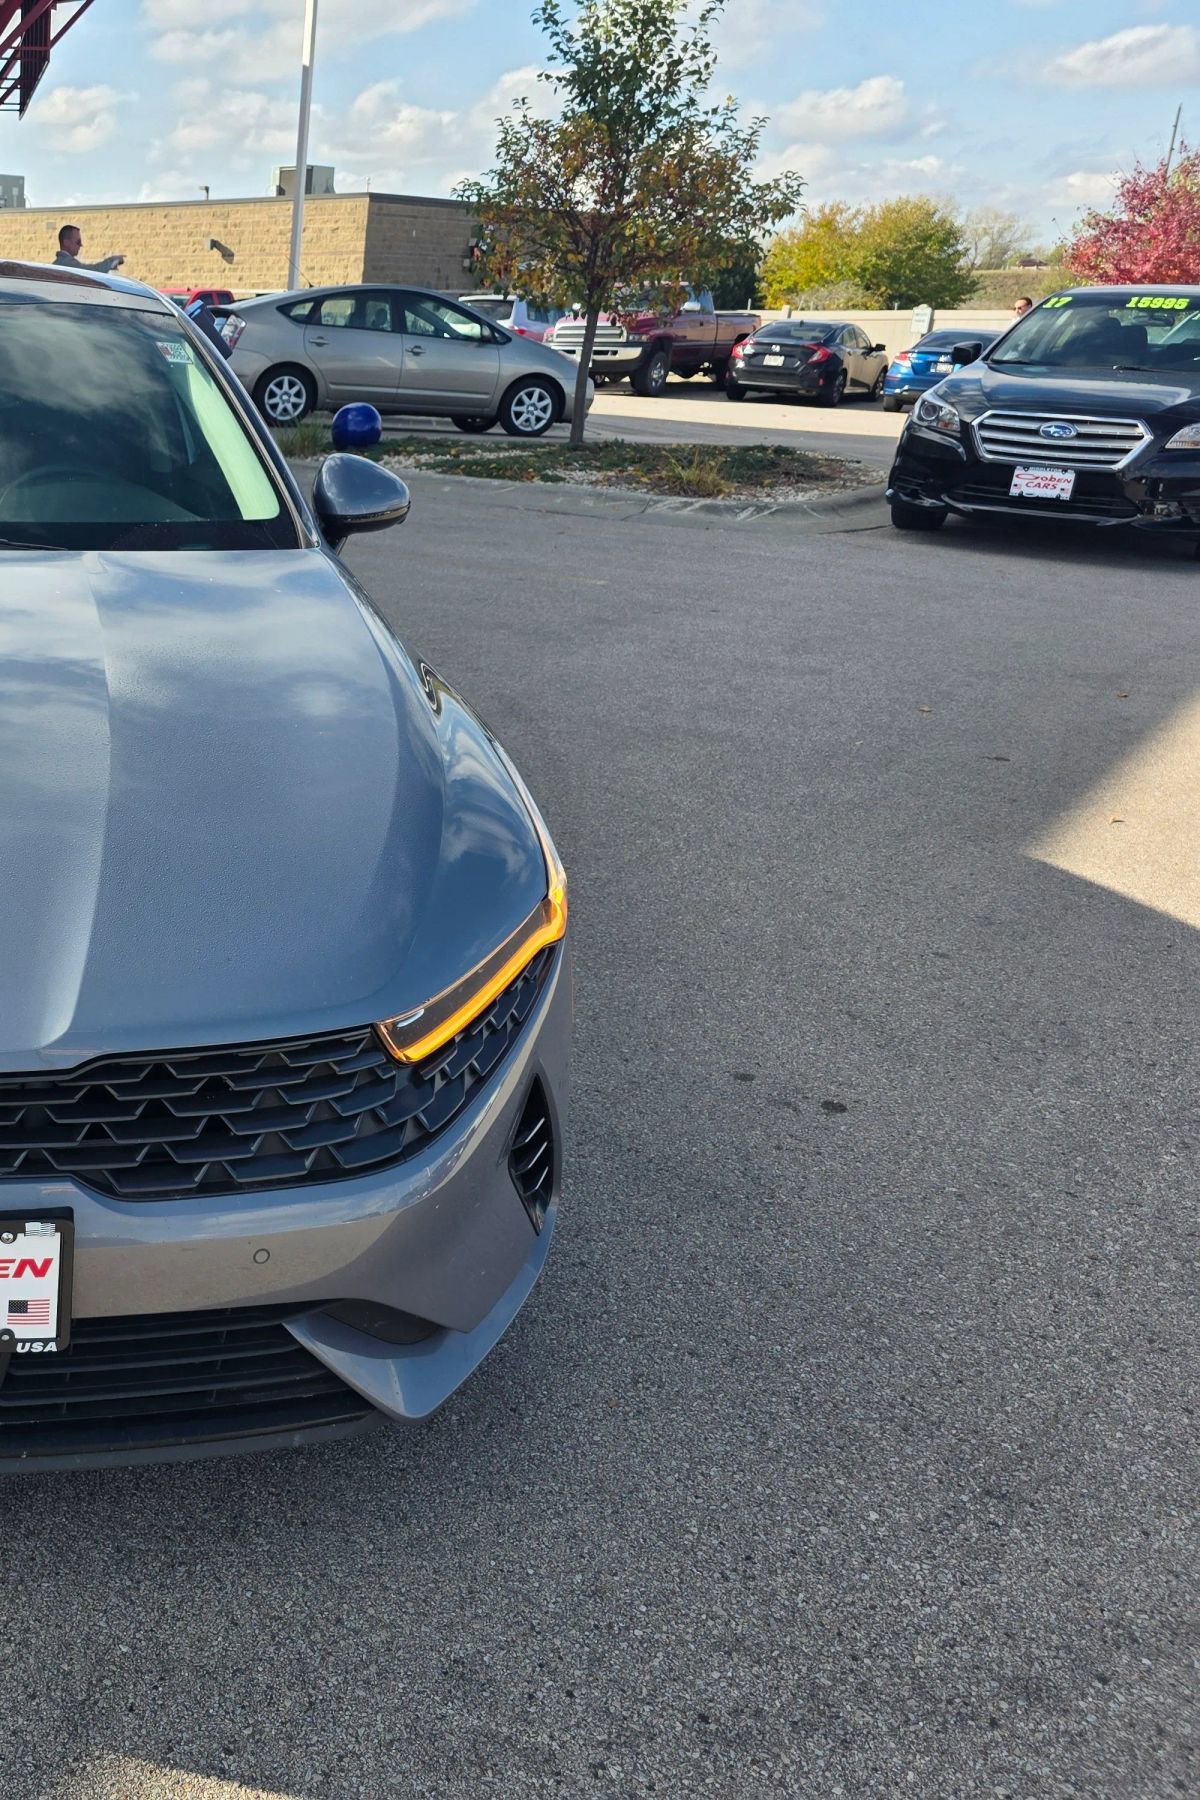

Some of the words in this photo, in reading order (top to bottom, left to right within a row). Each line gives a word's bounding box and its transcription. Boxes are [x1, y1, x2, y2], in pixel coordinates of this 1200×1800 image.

[1042, 296, 1073, 308] 17
[1126, 296, 1190, 309] 15995
[1025, 481, 1057, 490] CARS
[16, 1341, 58, 1353] USA
